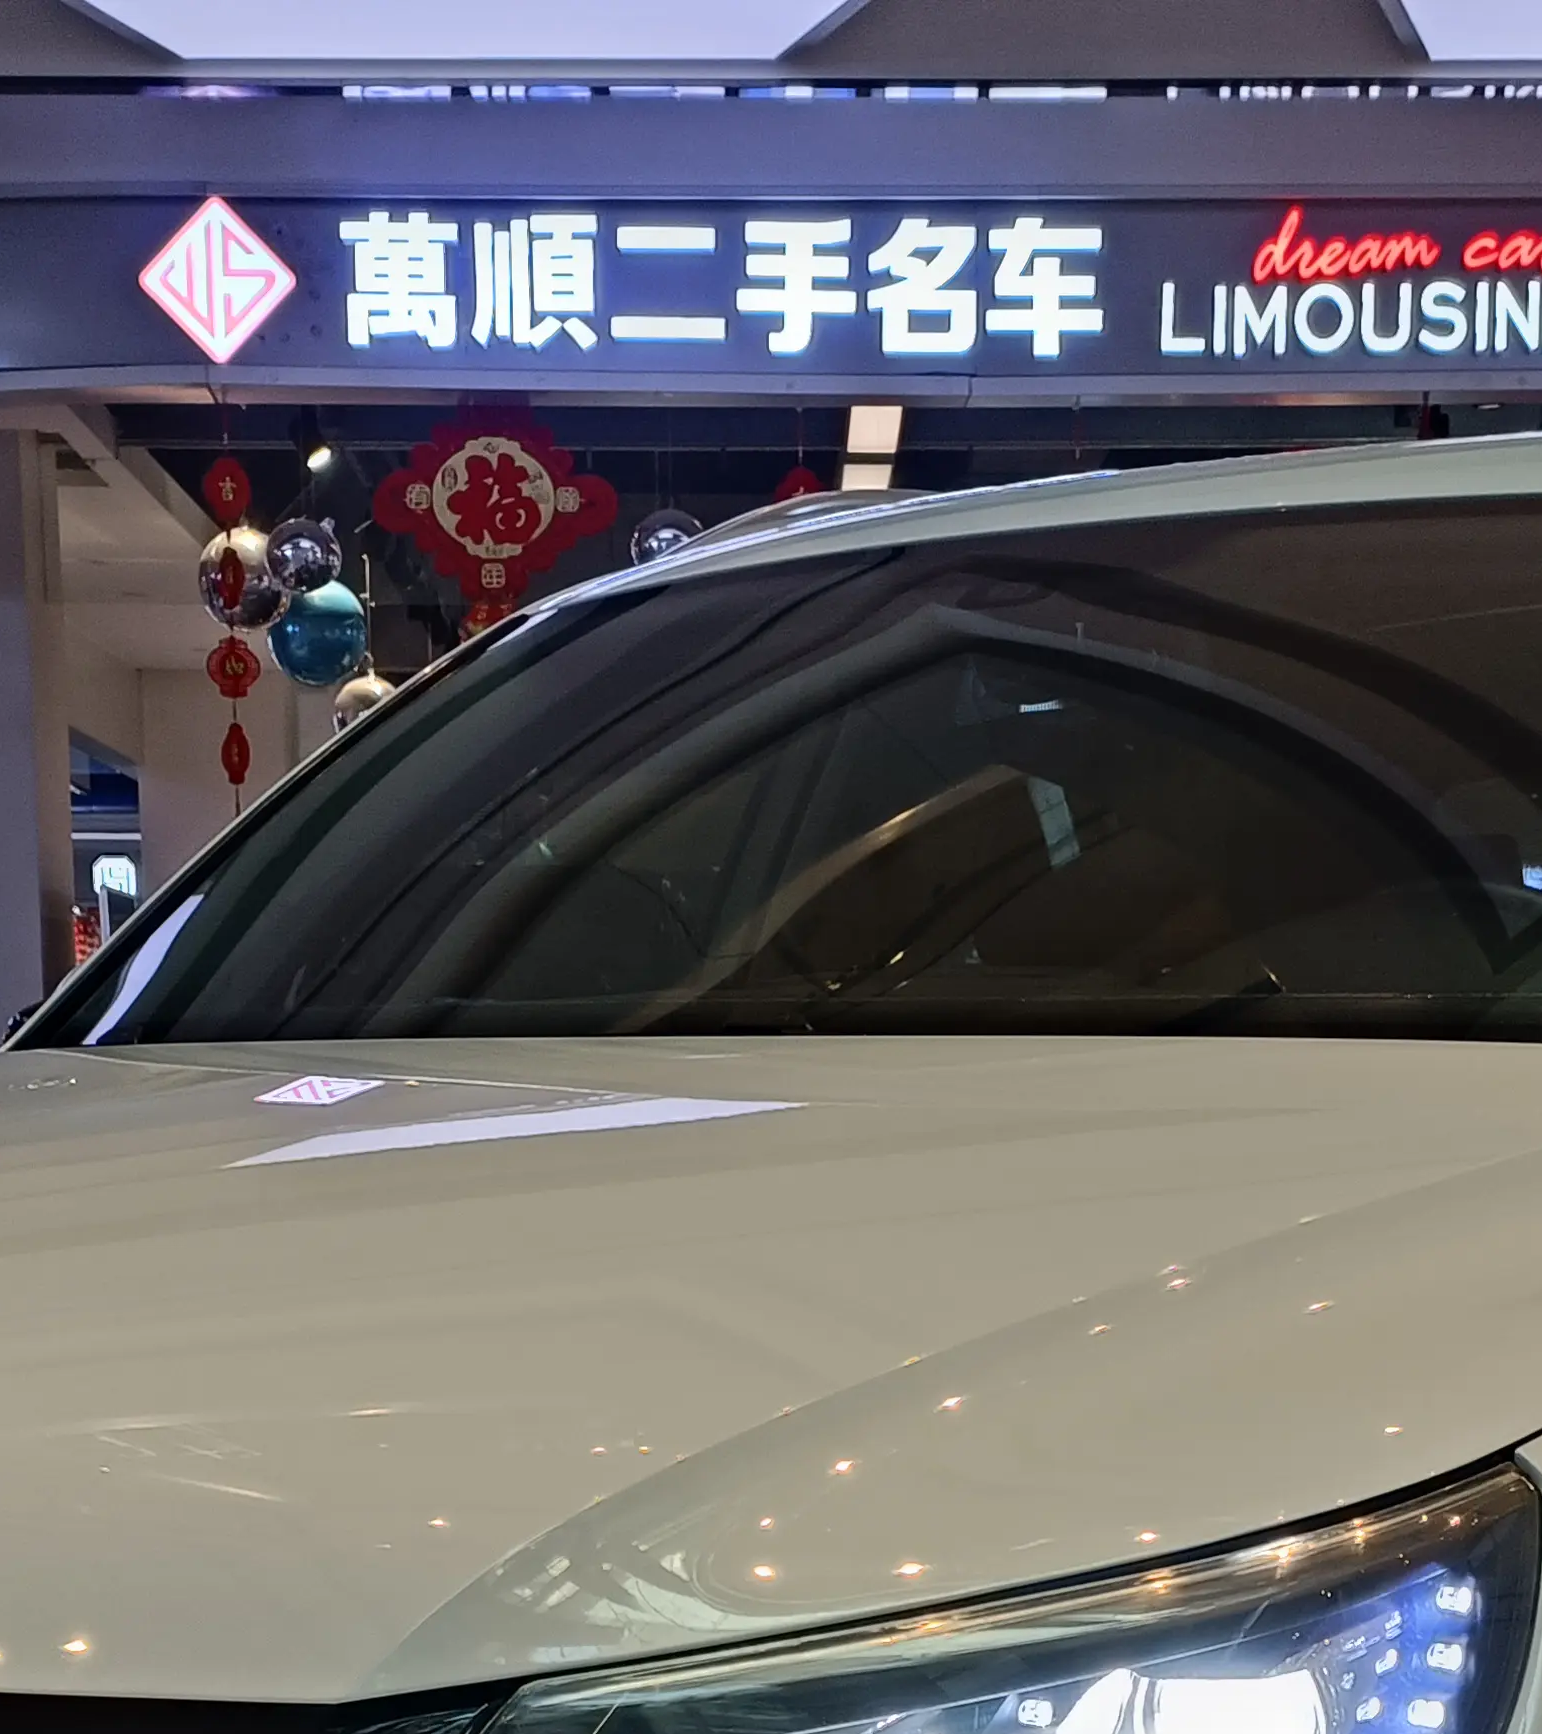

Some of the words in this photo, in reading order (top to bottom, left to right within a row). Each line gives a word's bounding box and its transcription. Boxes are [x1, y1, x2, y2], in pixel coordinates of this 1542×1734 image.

[338, 211, 1105, 360] 萬順二手名车
[1252, 205, 1441, 283] dream
